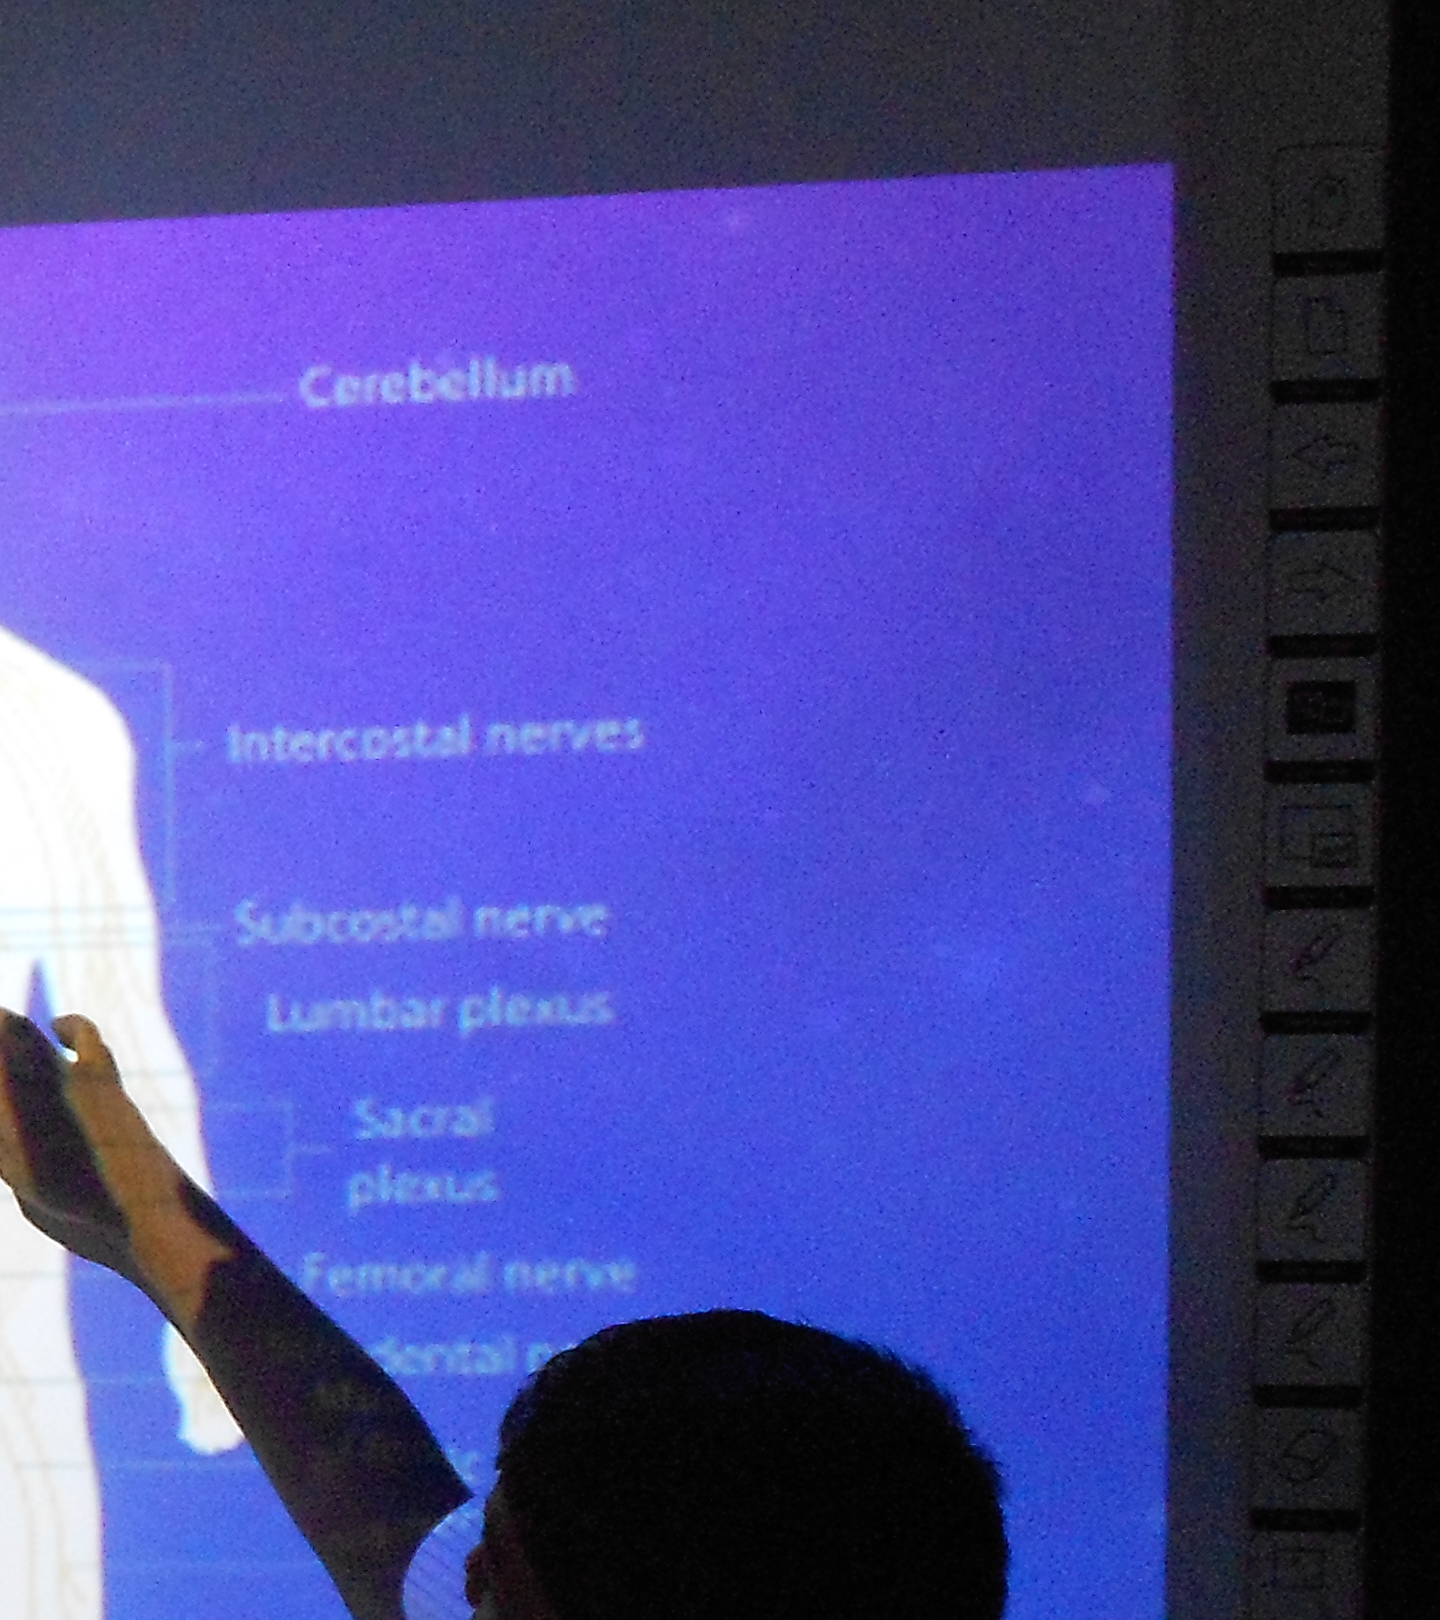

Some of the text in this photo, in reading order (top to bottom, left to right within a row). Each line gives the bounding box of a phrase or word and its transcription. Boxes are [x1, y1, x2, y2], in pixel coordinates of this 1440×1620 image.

[297, 357, 575, 410] Cerebellum
[227, 714, 644, 763] Intercostal nerves
[233, 899, 608, 947] Subcostal nerve
[266, 986, 613, 1038] Lumbar plexus
[354, 1098, 491, 1139] Sacral
[347, 1163, 498, 1215] plexus
[301, 1250, 634, 1297] Femoral nerve
